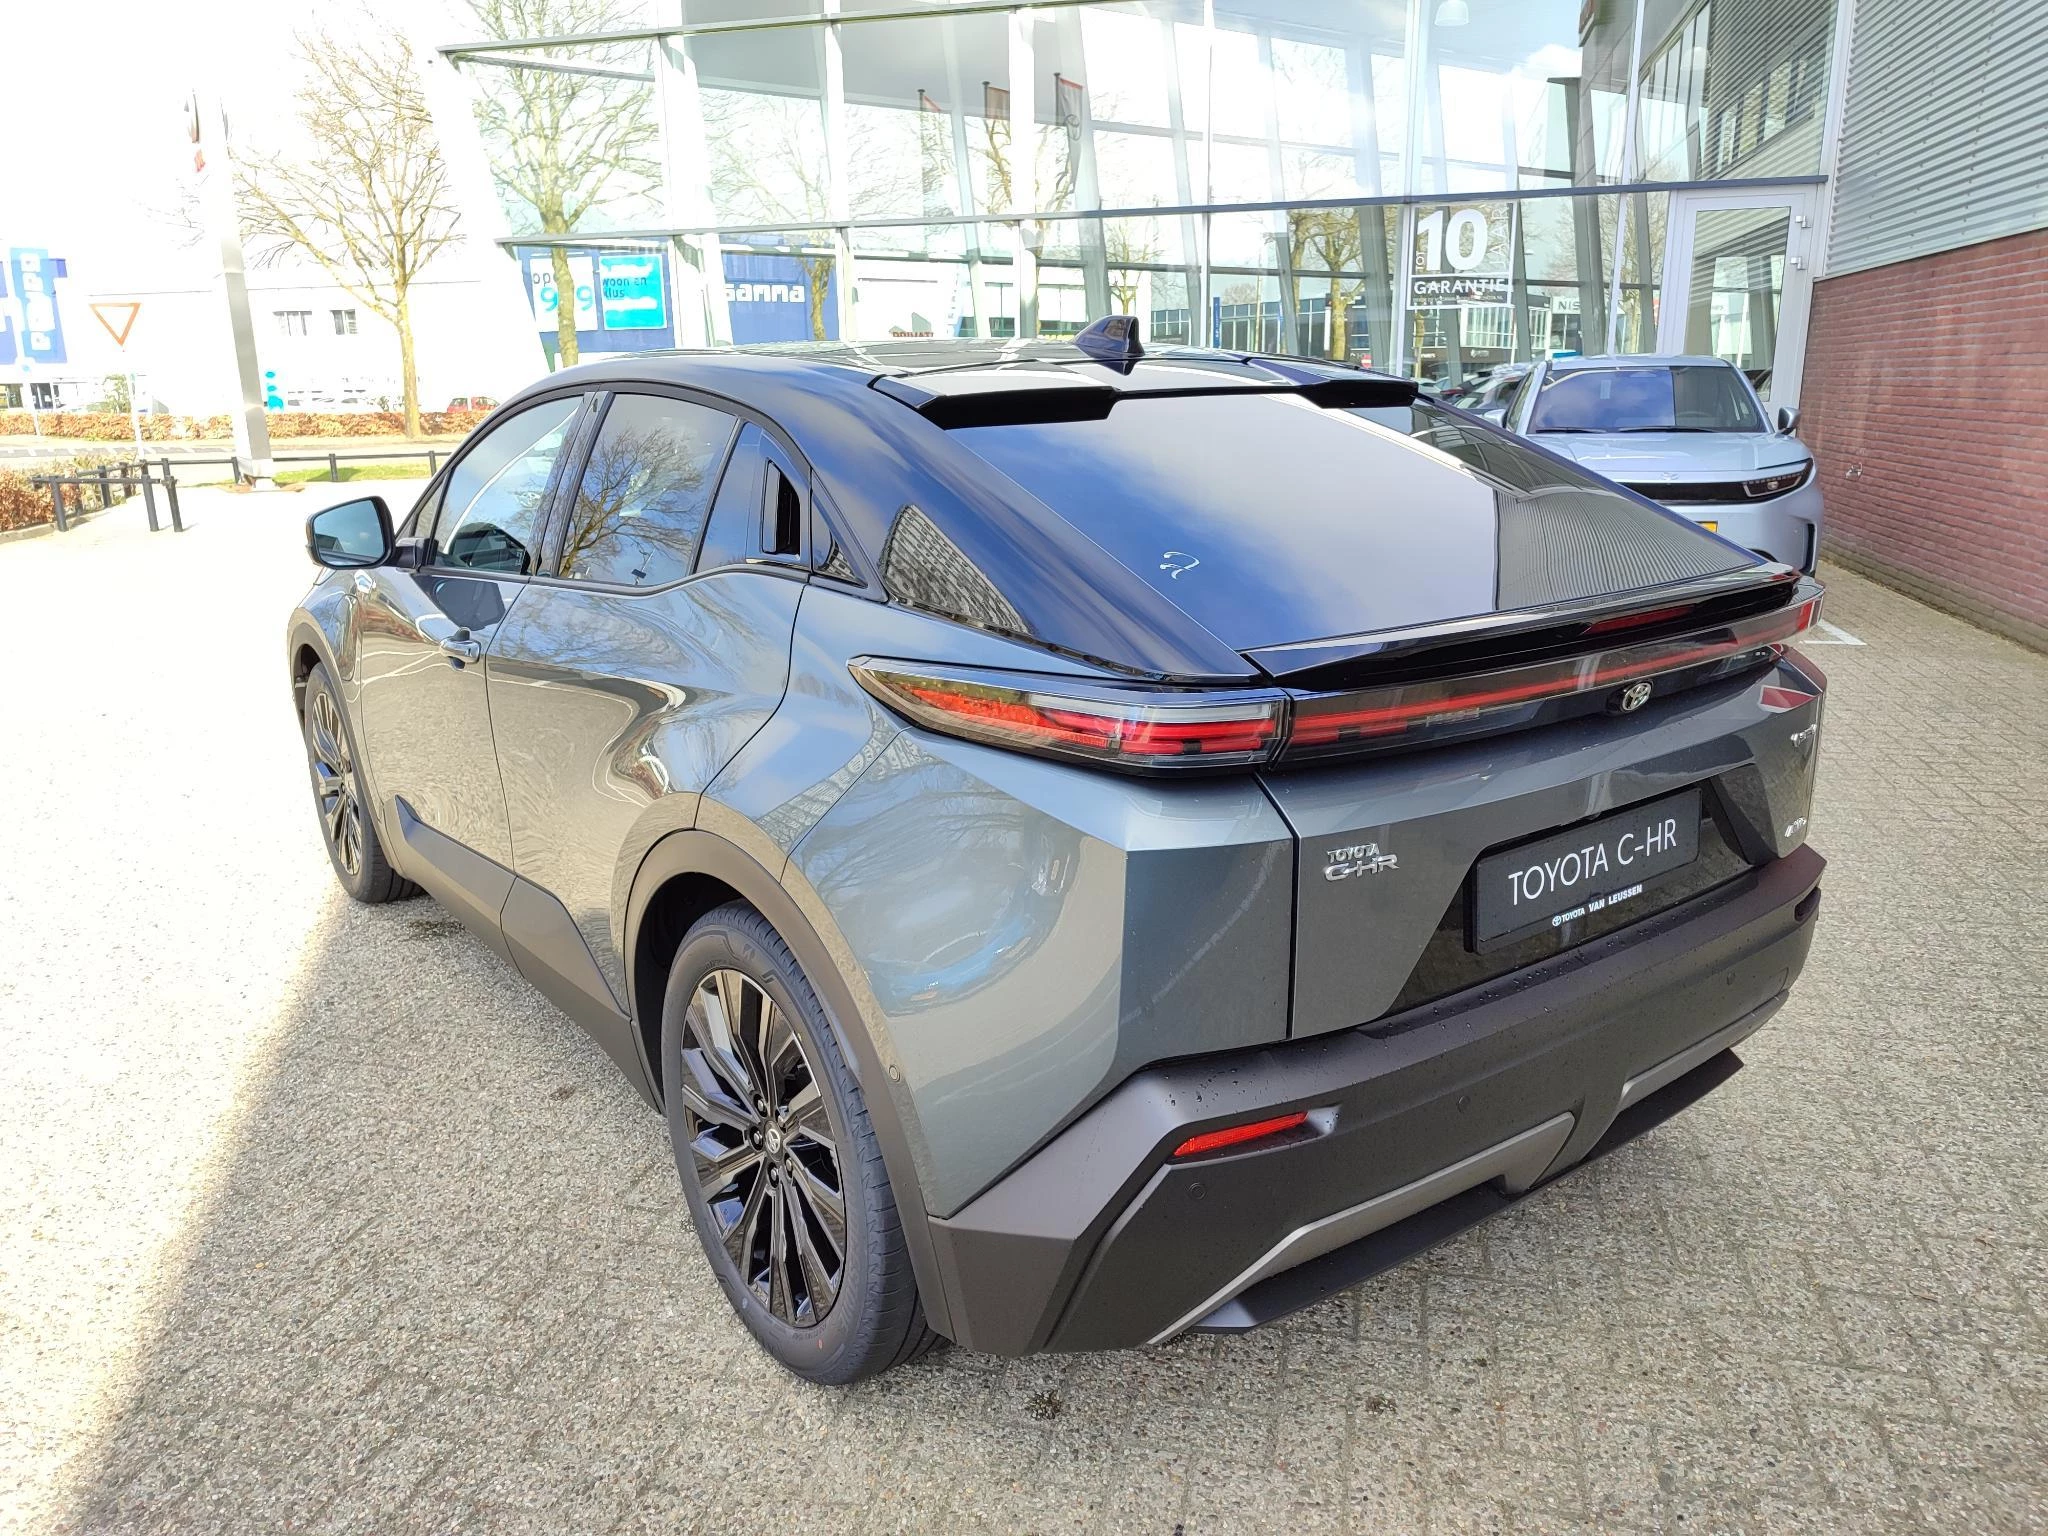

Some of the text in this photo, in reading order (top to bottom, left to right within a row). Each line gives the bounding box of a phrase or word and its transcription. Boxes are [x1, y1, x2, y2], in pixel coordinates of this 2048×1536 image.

[1416, 208, 1488, 271] 10
[576, 286, 593, 311] 9
[1413, 279, 1506, 295] GARANTIE
[1327, 842, 1380, 864] TOYOTA
[1508, 818, 1678, 906] TOYOTA C-HR
[1325, 854, 1400, 881] C-HR
[1561, 884, 1643, 923] TOYOTA VAN LEUSSEN
